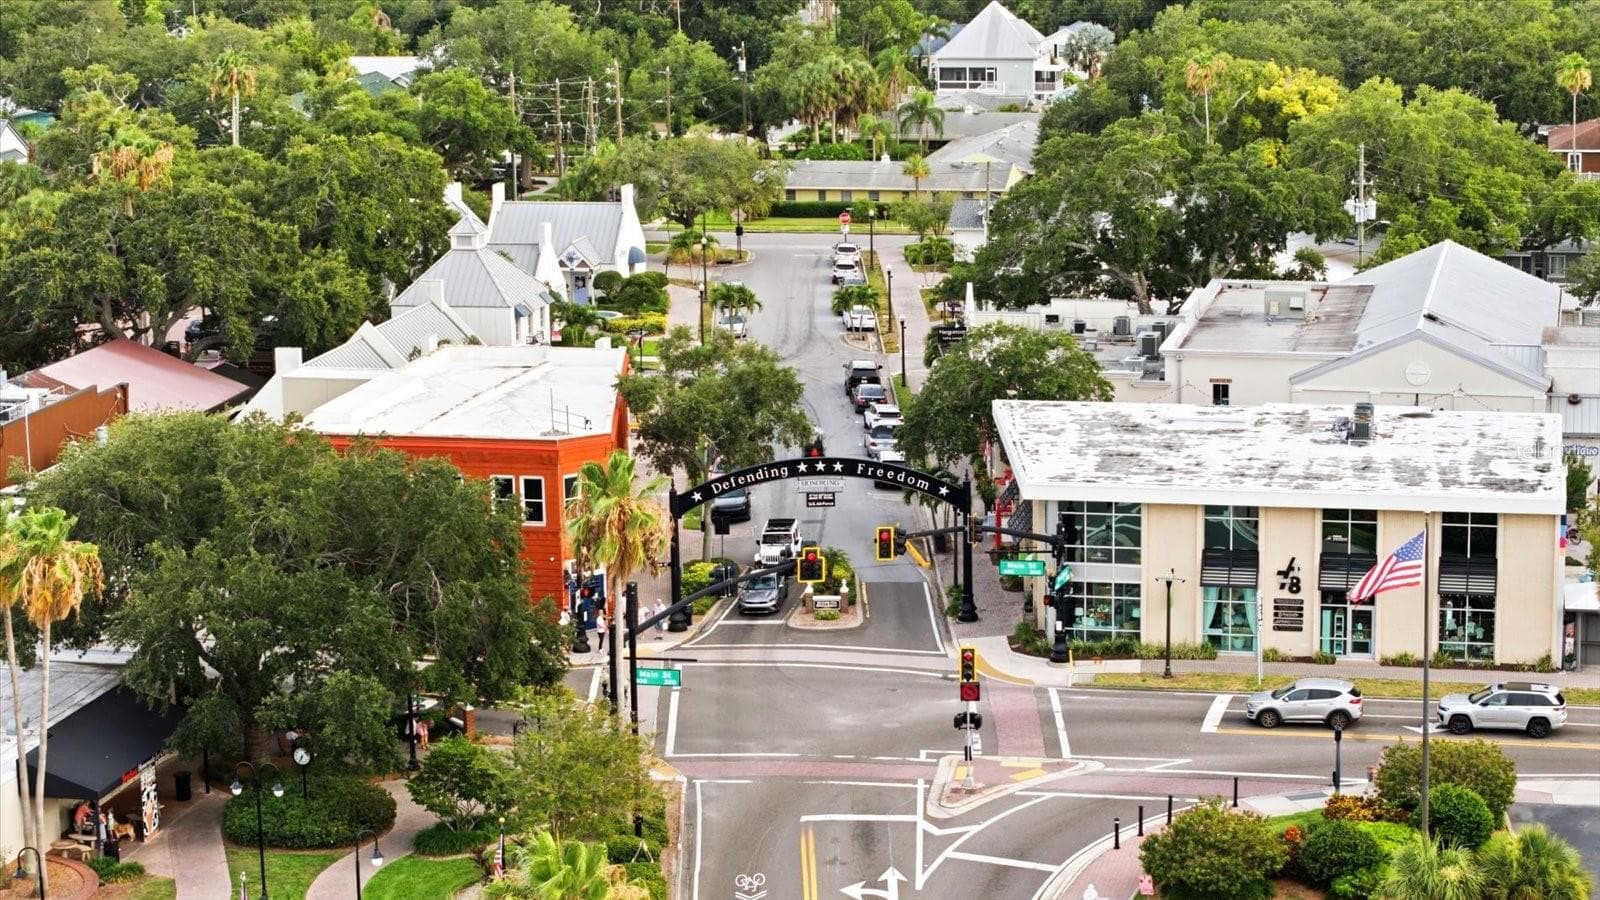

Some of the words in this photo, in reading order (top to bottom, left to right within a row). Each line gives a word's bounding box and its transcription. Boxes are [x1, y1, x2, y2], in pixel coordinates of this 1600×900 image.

[711, 466, 789, 495] Defending
[856, 463, 930, 491] Freedom
[639, 670, 659, 678] Main
[662, 671, 671, 679] St
